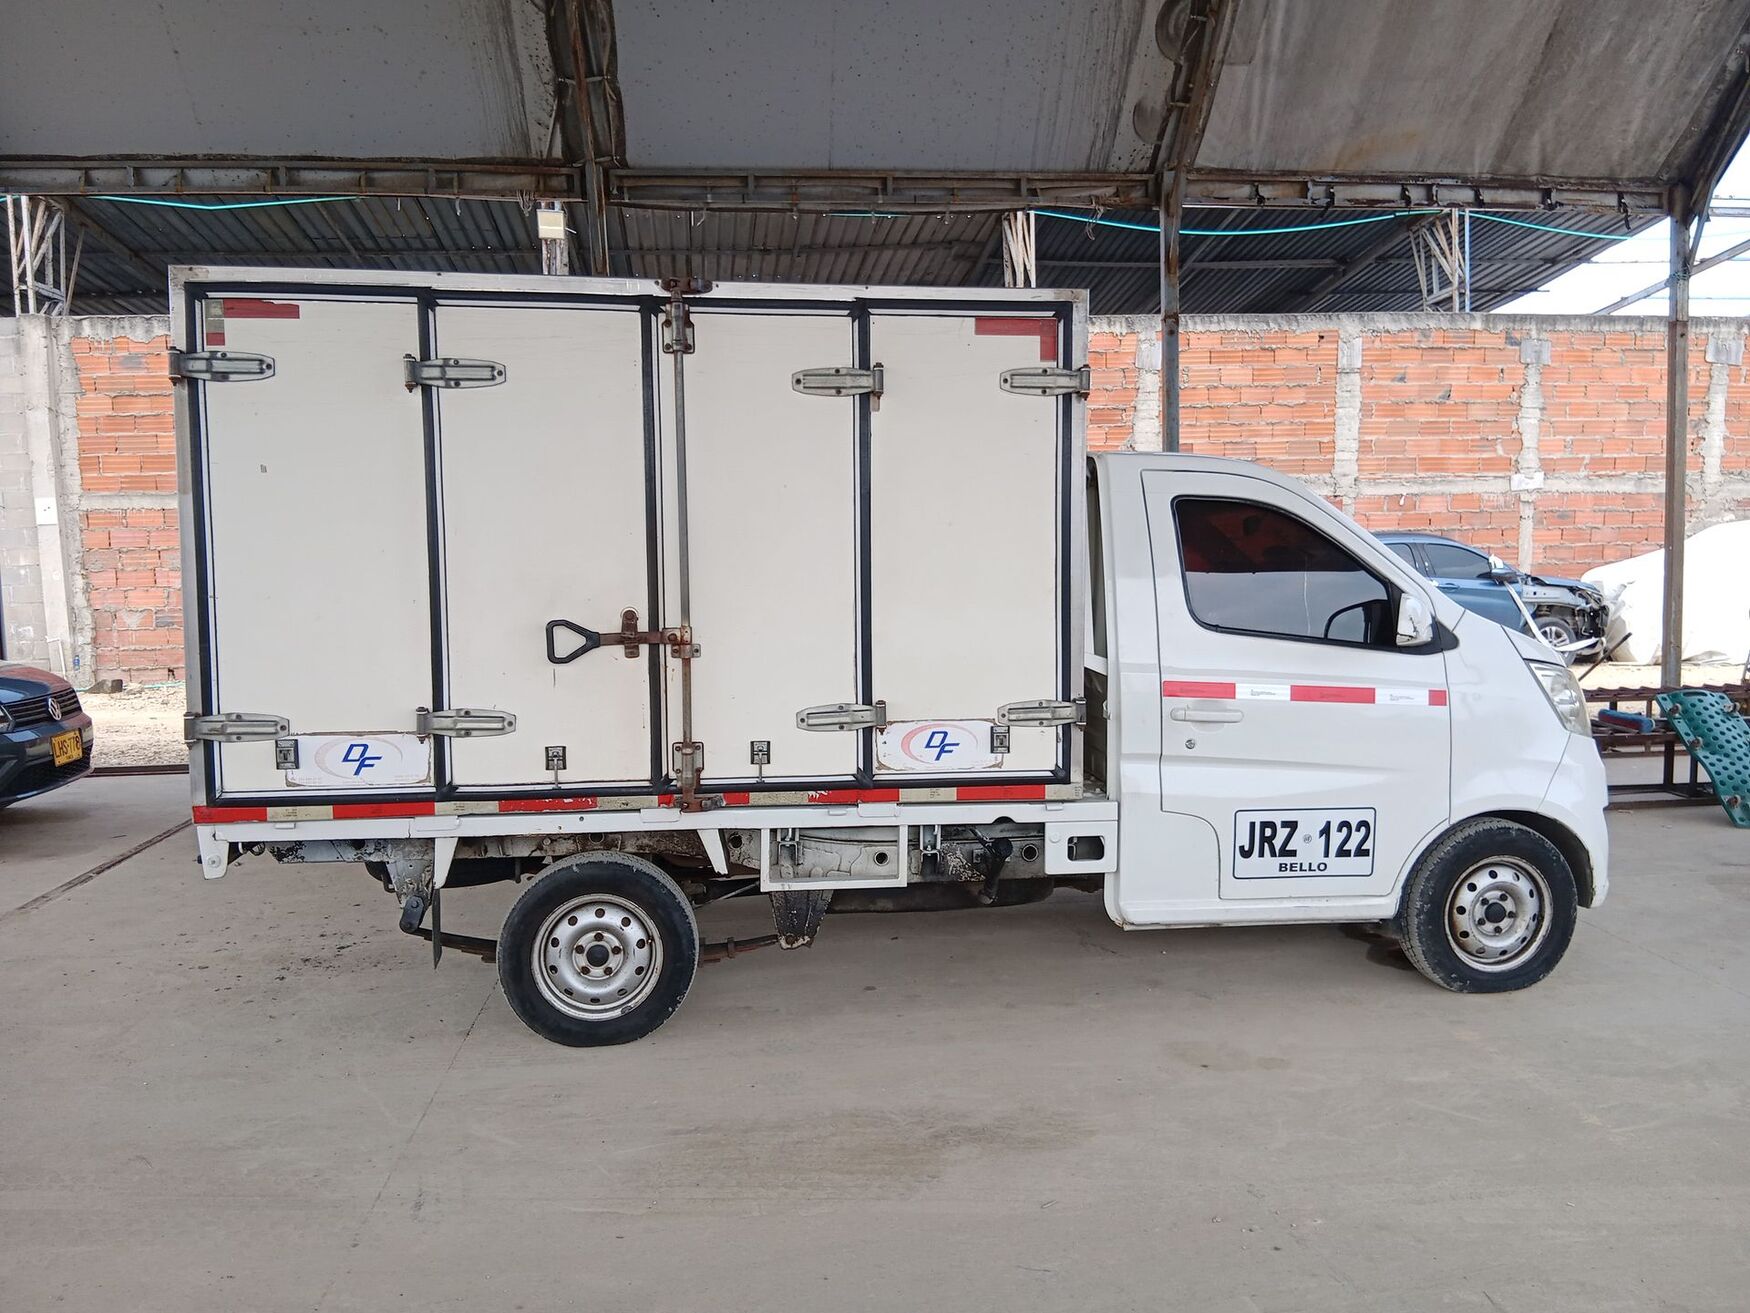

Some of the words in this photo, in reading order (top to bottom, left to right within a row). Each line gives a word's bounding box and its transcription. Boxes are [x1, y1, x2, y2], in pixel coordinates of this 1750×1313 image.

[341, 743, 384, 776] DF
[924, 731, 961, 761] DF
[1238, 820, 1299, 859] JRZ
[1318, 819, 1371, 859] 122
[1278, 862, 1328, 873] BELLO
